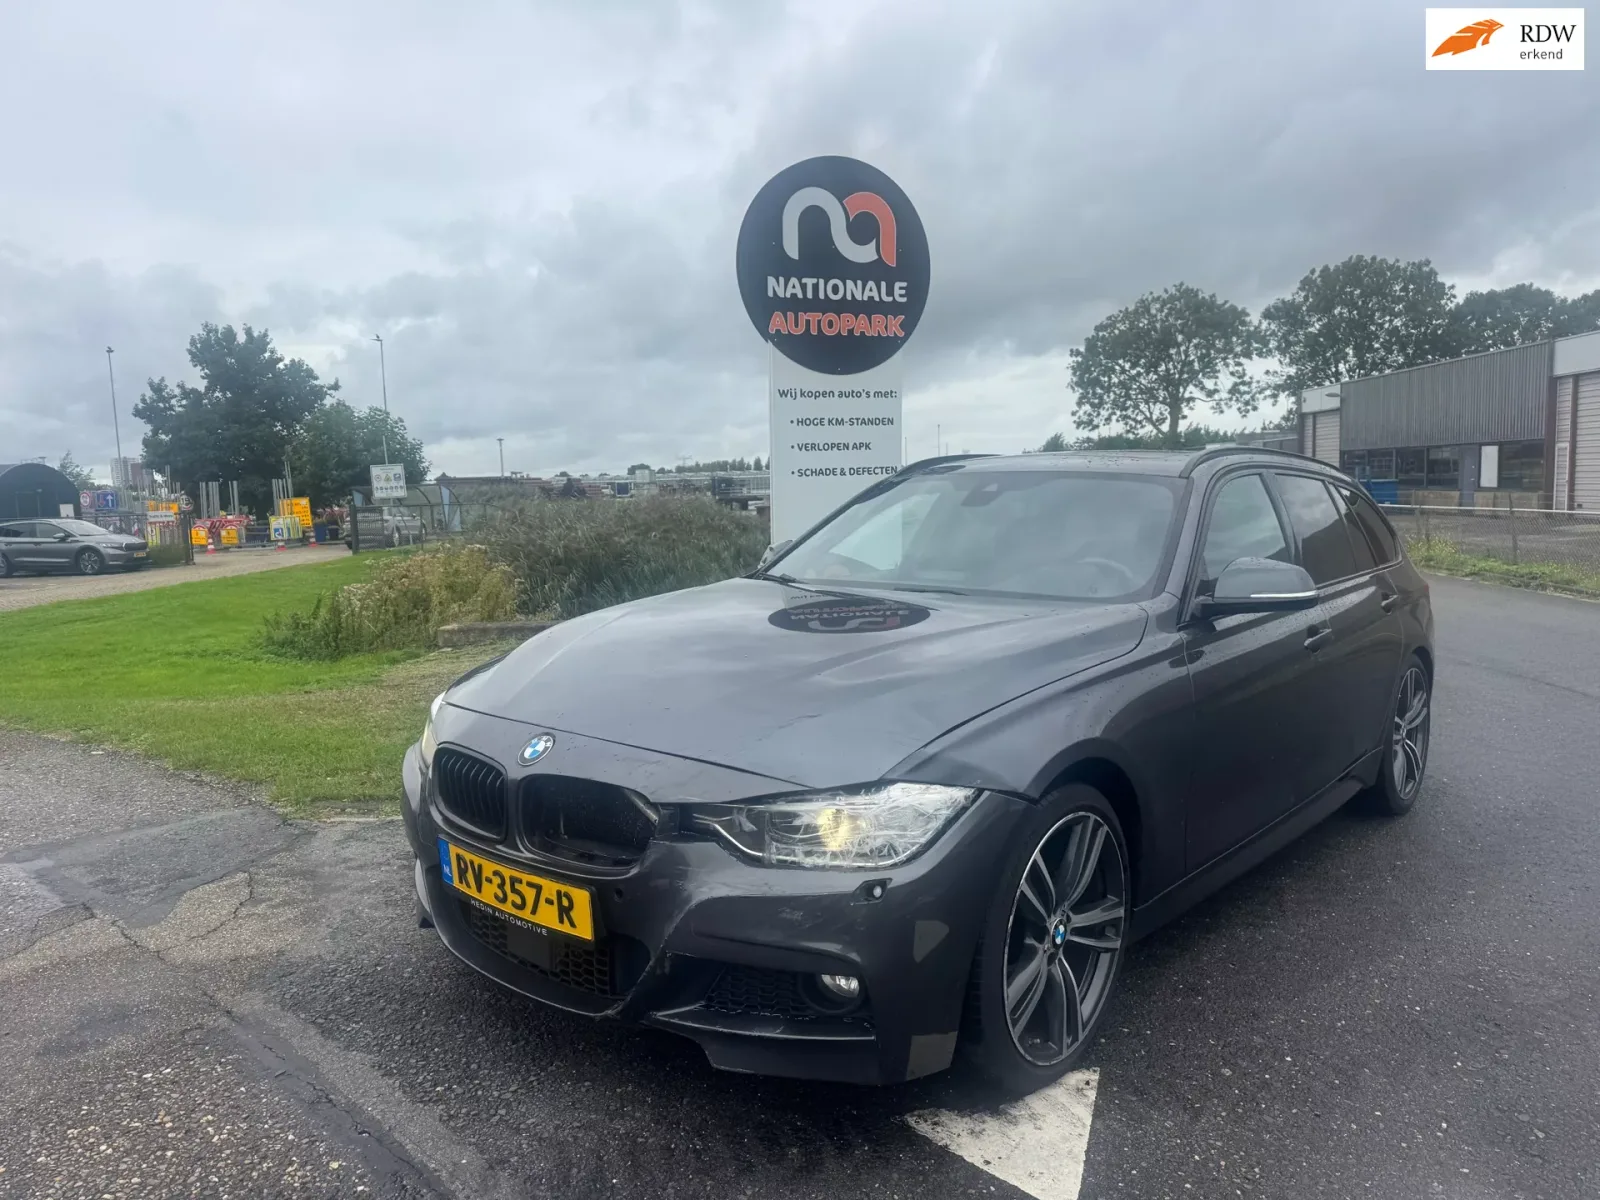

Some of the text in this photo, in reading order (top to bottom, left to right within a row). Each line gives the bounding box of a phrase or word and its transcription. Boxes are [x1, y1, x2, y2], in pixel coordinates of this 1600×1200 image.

[767, 275, 907, 302] NATIONALE
[768, 311, 905, 337] AUTOPARK
[778, 388, 898, 400] Wij kopen auto's met:
[796, 417, 894, 426] HOGE KM-STANDEN
[797, 442, 872, 452] VERLOPEN APK
[797, 466, 898, 477] SCHADE & DEFECTEN
[455, 852, 577, 929] RV-357-R
[470, 898, 548, 936] HEDIN AUTOMOTIVE
